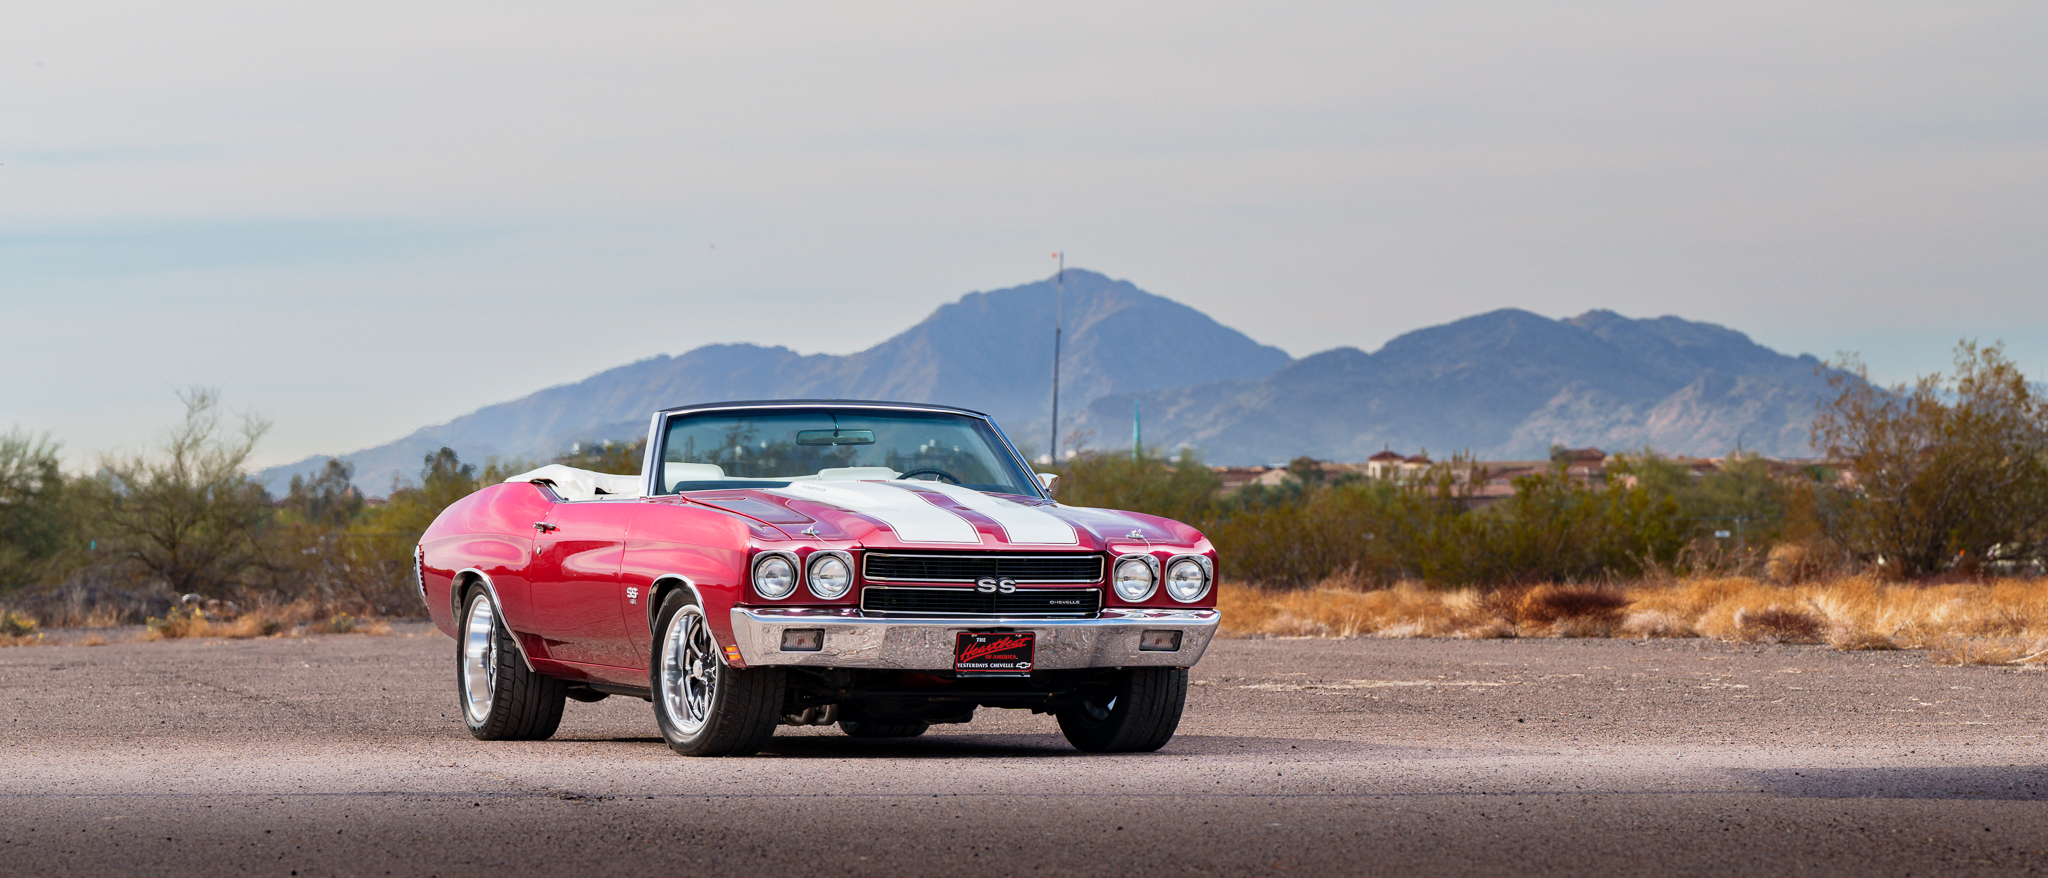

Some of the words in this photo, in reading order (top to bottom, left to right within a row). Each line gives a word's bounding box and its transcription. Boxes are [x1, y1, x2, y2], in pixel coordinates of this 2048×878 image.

[627, 586, 638, 598] SS
[978, 578, 1016, 594] SS
[960, 636, 1032, 661] Heartbeat
